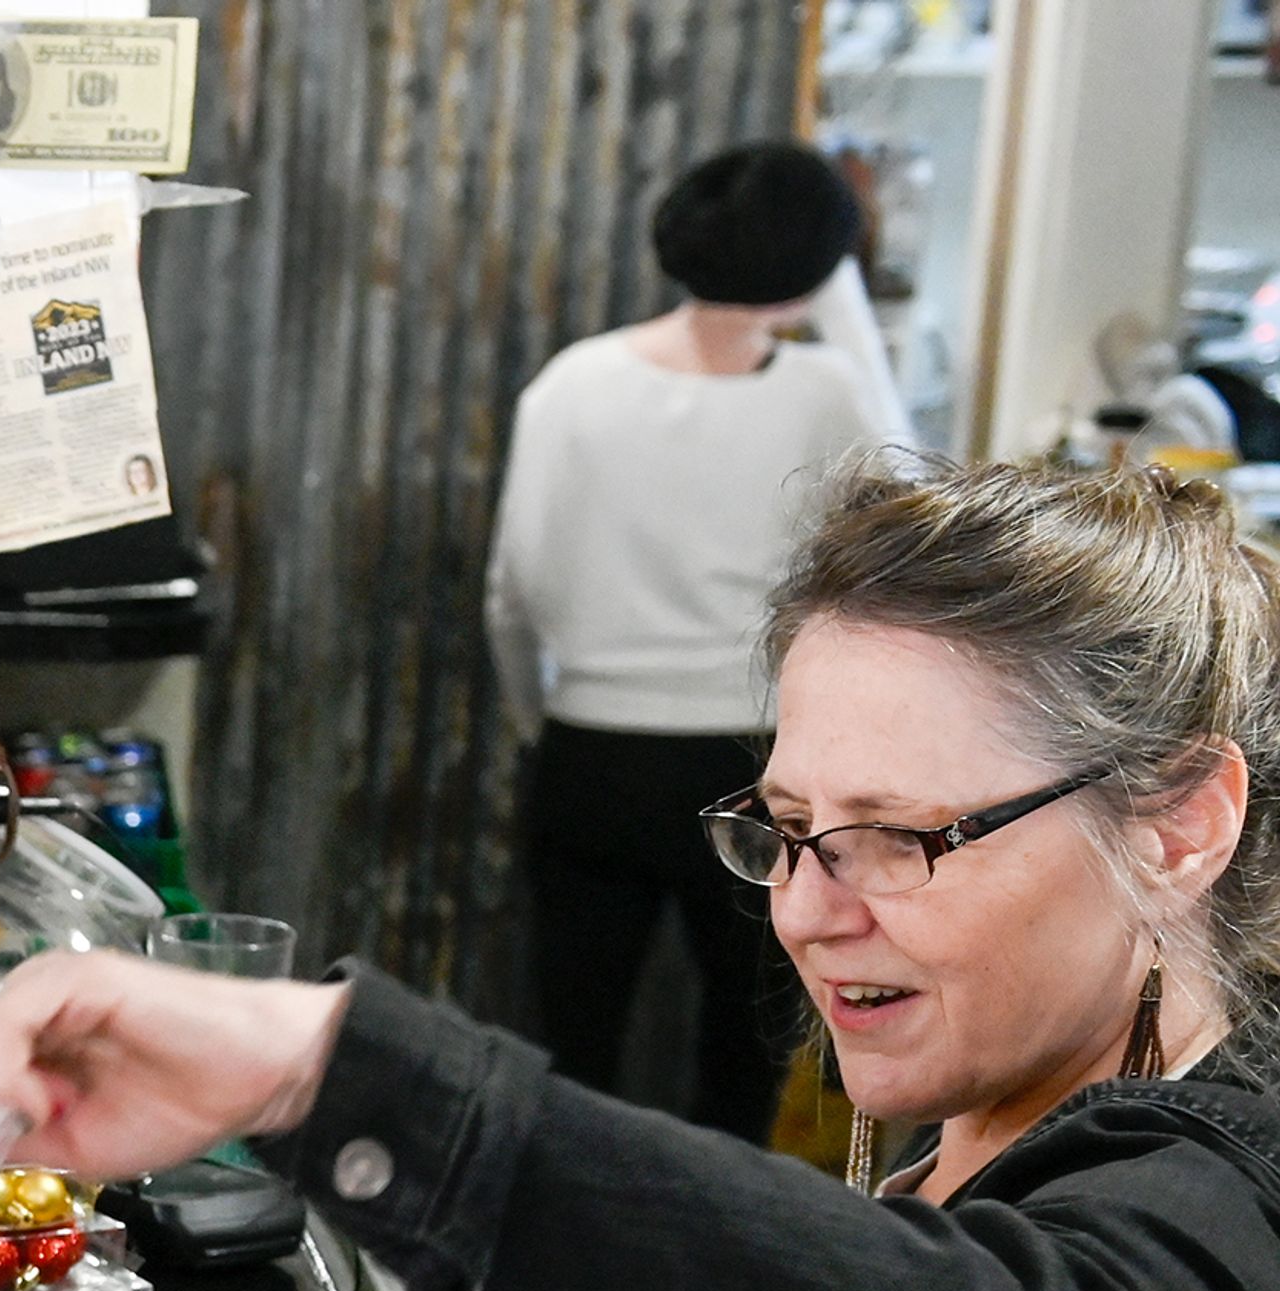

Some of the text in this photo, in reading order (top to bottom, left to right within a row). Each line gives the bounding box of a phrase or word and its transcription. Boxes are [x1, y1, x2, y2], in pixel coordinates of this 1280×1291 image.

[0, 251, 31, 271] time
[33, 247, 50, 262] to
[0, 277, 16, 295] of
[16, 273, 39, 292] the
[40, 262, 83, 286] Inland
